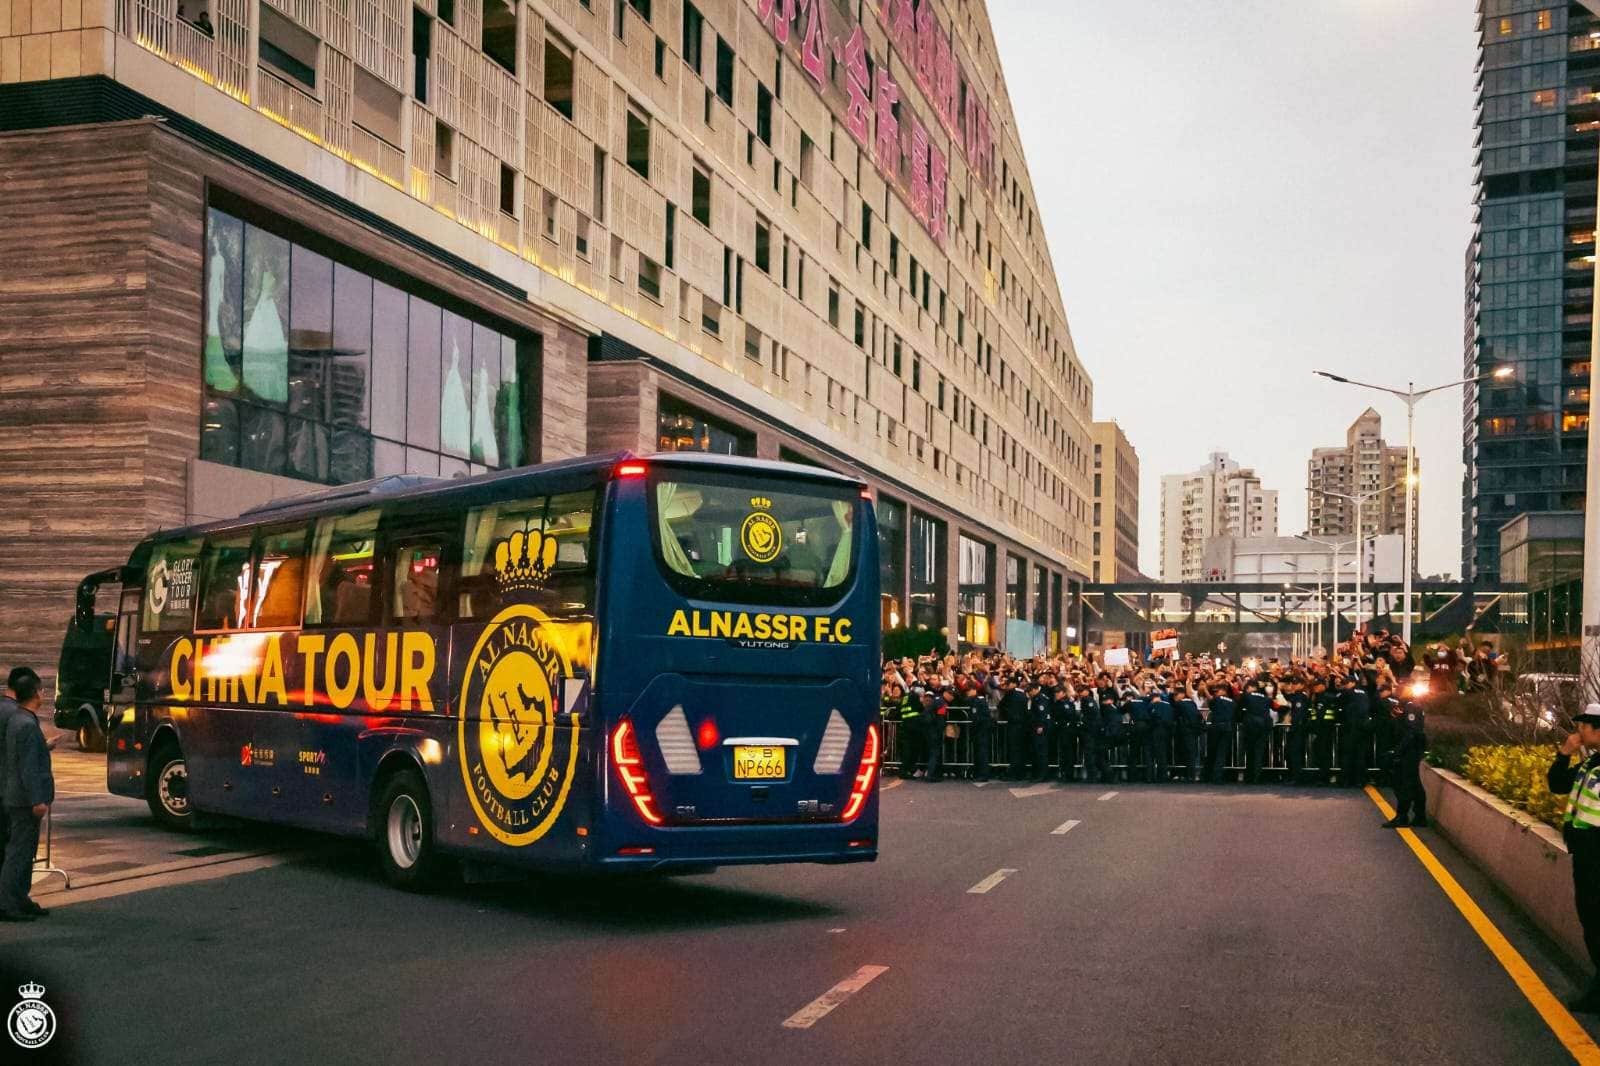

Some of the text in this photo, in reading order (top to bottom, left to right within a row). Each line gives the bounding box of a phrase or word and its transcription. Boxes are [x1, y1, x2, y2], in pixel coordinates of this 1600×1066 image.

[174, 559, 194, 572] GLORY
[172, 572, 192, 585] SOCCER
[171, 585, 190, 598] TOUR
[667, 609, 852, 643] ALNASSR F.C
[479, 621, 560, 686] AL NASSR
[738, 640, 789, 649] YUTONG
[298, 631, 436, 712] TOUR
[737, 759, 783, 777] NP666
[473, 762, 560, 826] FOOTBALL CLUB
